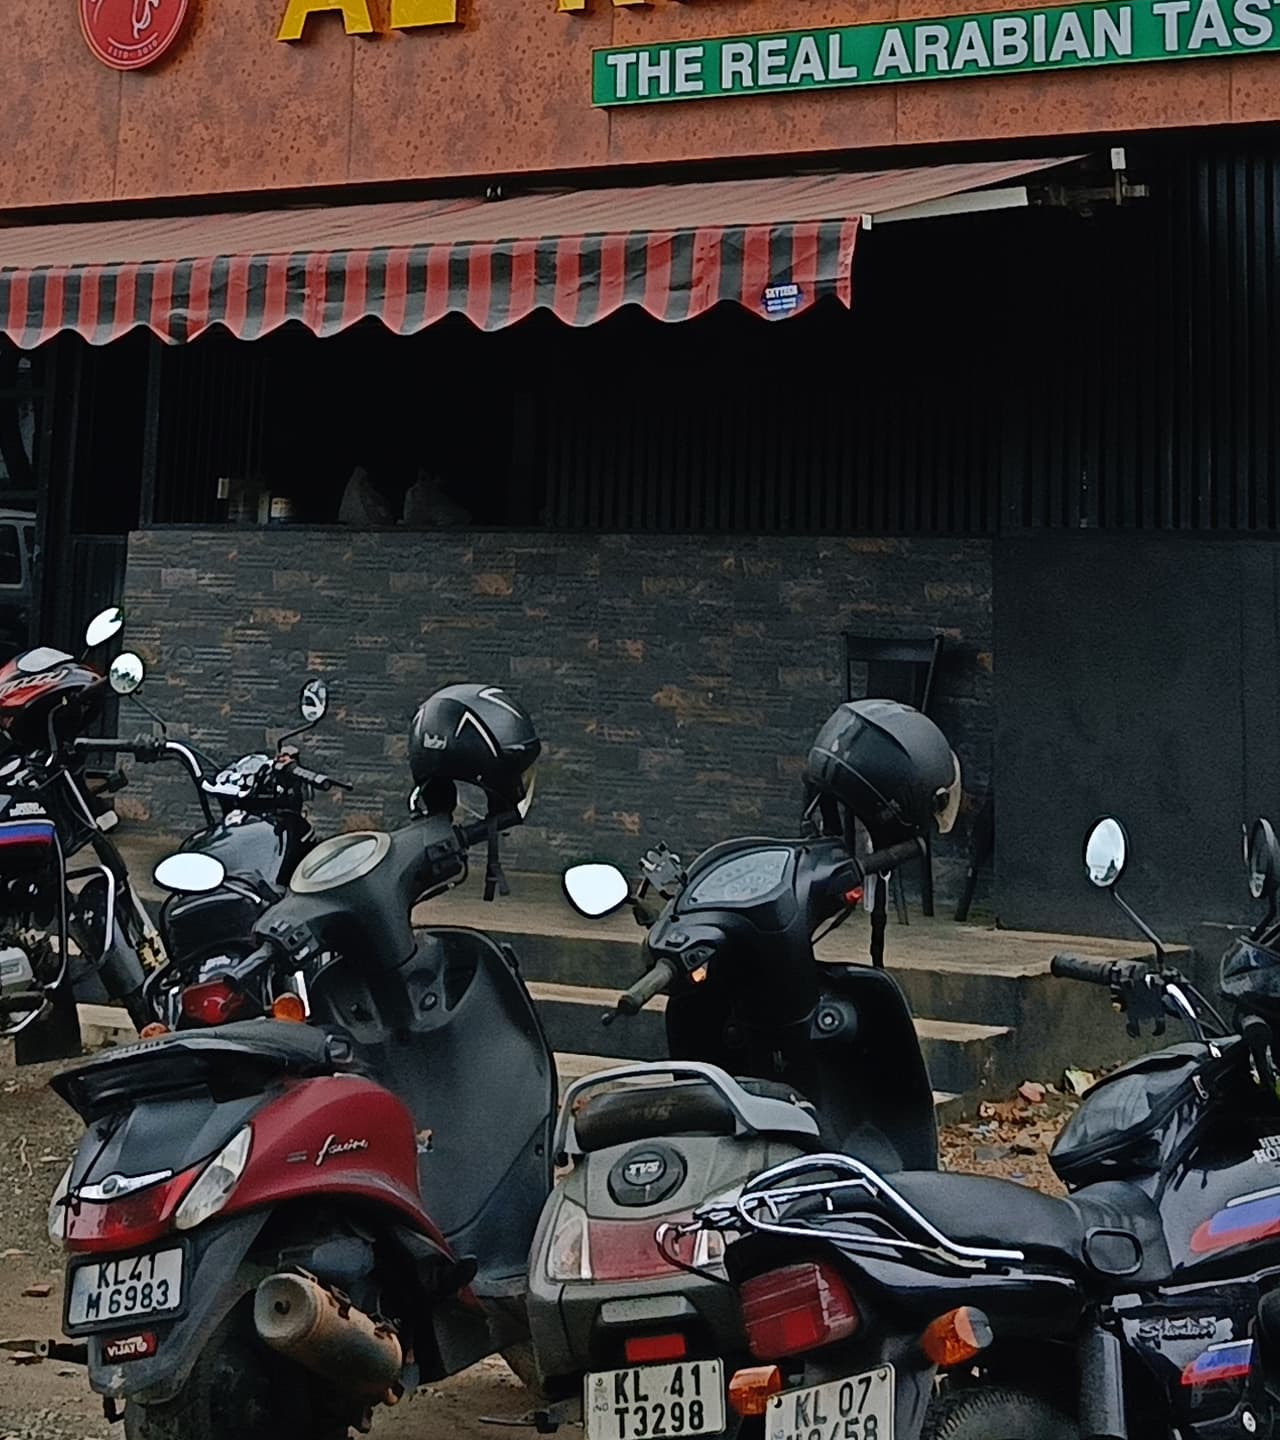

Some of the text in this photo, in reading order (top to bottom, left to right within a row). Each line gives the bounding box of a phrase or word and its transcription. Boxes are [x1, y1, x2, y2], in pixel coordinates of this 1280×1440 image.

[606, 48, 704, 100] THE
[720, 34, 857, 91] REAL
[873, 4, 1133, 76] ARABIAN
[628, 1160, 661, 1176] TVS
[614, 1364, 702, 1404] KL 41
[795, 1376, 872, 1430] KL 07
[614, 1400, 704, 1439] T3298
